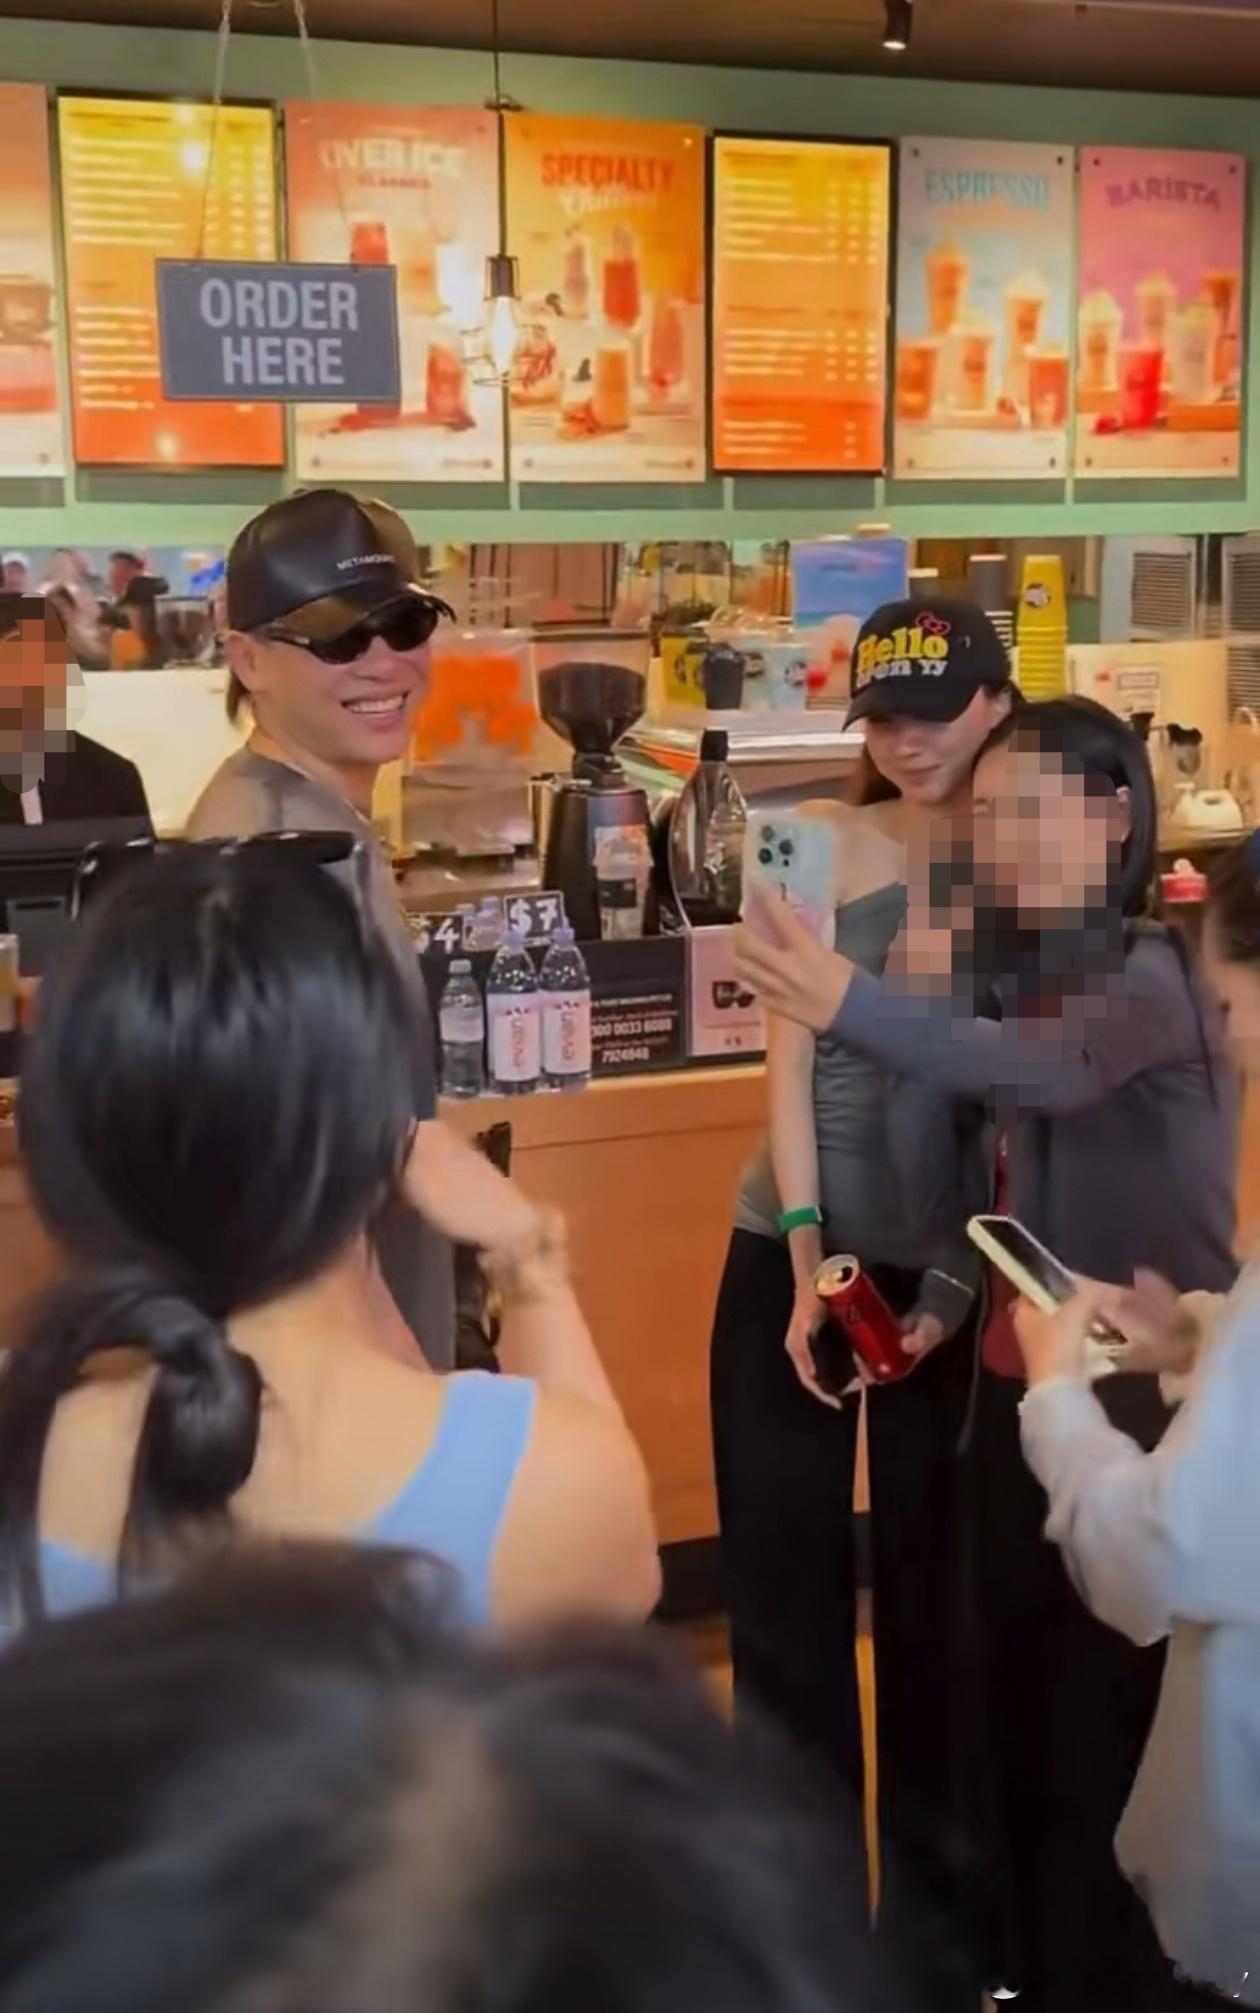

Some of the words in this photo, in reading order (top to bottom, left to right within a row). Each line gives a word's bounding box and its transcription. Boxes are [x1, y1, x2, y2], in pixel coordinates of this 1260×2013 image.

[540, 153, 675, 191] SPECIALTY
[1105, 177, 1221, 212] BARISTA
[200, 278, 358, 331] ORDER
[222, 336, 345, 385] HERE
[510, 898, 558, 935] $7
